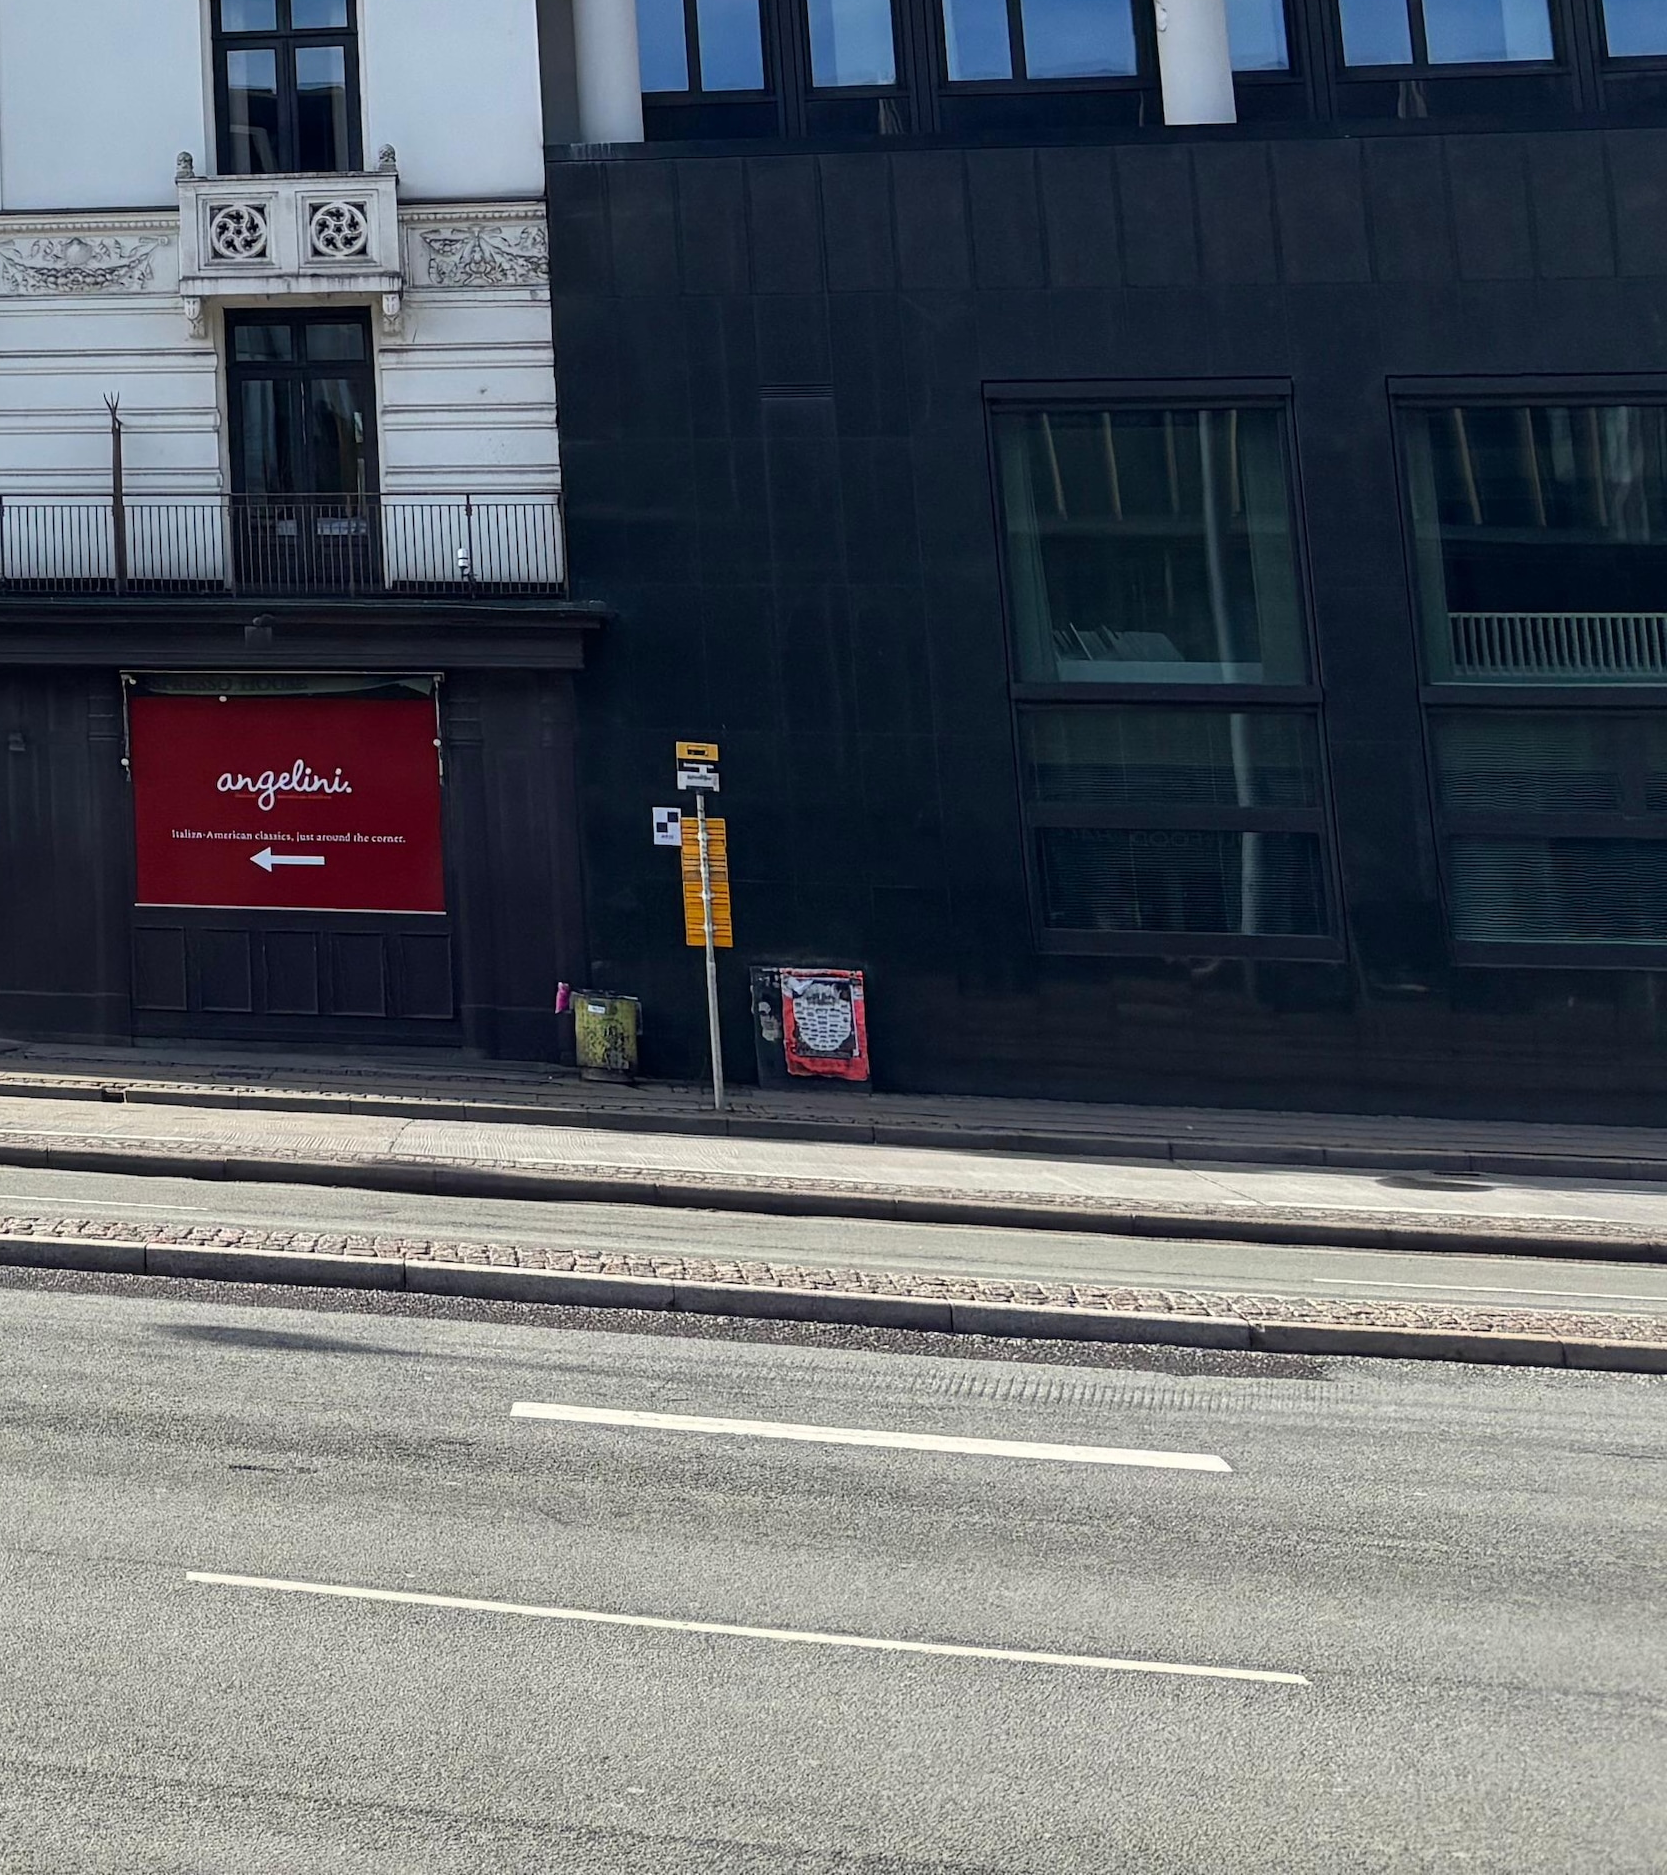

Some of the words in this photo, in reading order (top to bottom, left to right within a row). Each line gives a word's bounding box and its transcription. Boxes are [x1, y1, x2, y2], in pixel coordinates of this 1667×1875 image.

[216, 759, 353, 811] angelini.
[296, 831, 314, 843] just
[316, 832, 351, 843] around
[353, 832, 370, 843] the
[371, 833, 406, 844] corner.
